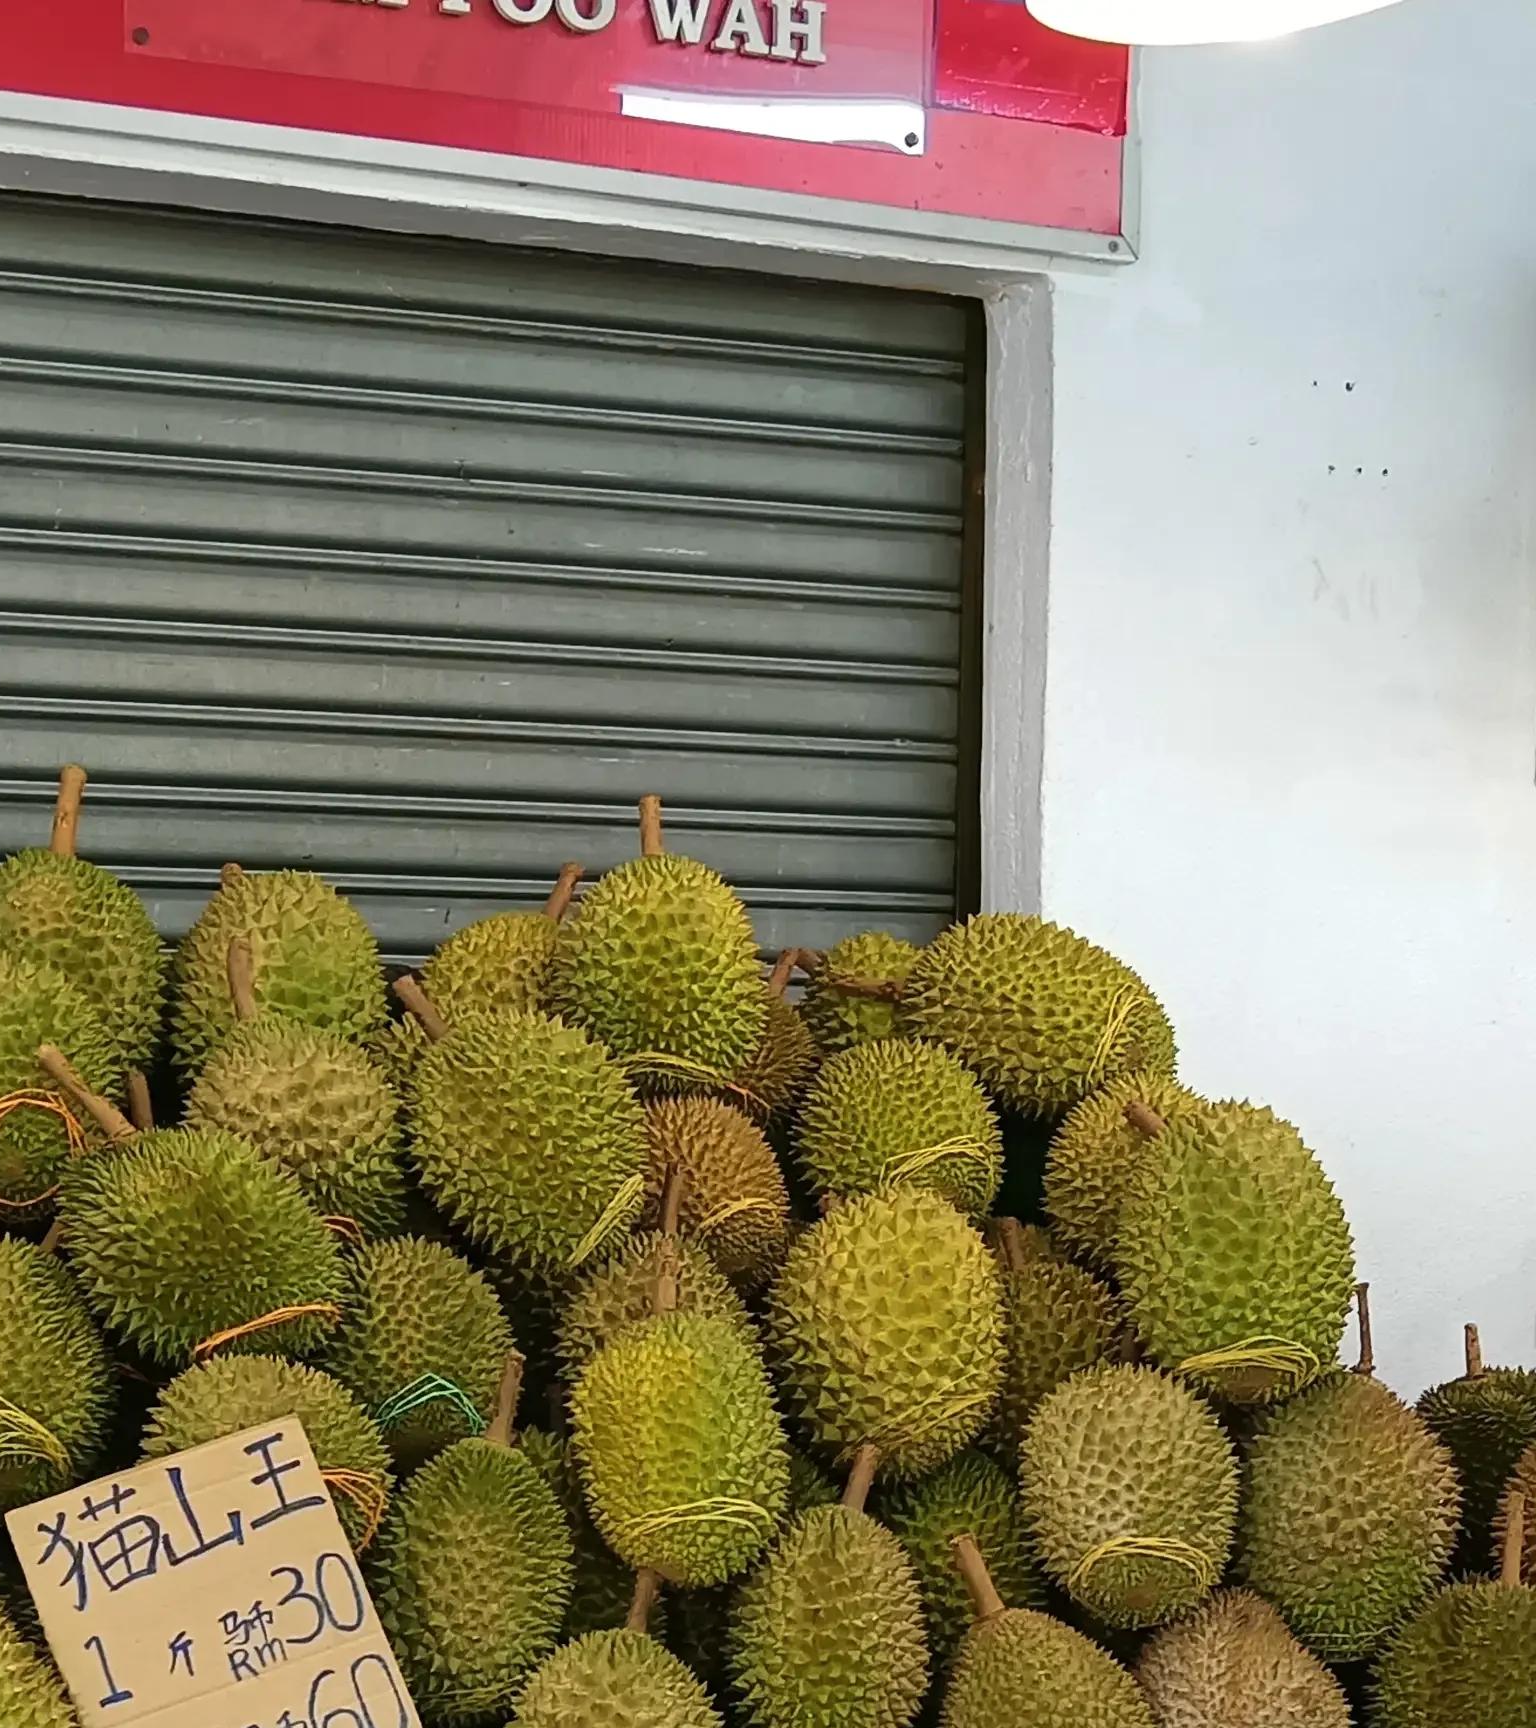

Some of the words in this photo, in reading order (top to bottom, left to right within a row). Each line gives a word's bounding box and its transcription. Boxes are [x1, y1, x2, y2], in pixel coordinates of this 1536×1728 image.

[648, 0, 827, 65] WAH
[37, 1432, 327, 1611] 猫山王
[270, 1552, 365, 1644] 30
